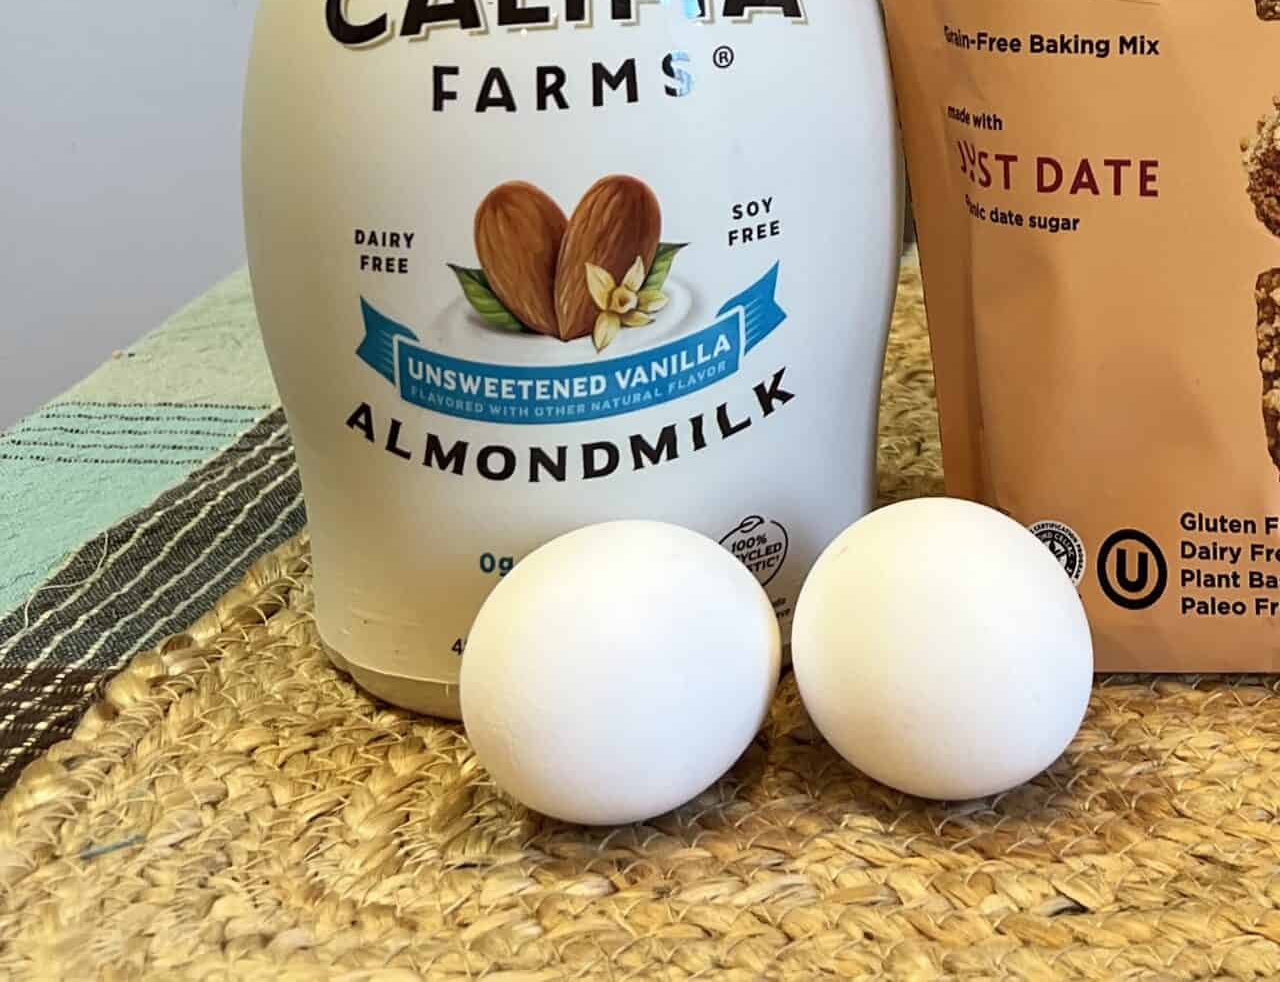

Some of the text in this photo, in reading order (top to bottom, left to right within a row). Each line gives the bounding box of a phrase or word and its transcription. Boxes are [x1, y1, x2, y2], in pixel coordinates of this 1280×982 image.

[1029, 34, 1110, 58] Baking
[1119, 35, 1160, 55] Mix
[973, 113, 1003, 130] with
[1036, 156, 1159, 197] DATE
[732, 197, 774, 220] SOY
[989, 207, 1023, 227] date
[1028, 213, 1080, 233] sugar
[354, 229, 415, 250] DAIRY
[728, 220, 781, 247] FREE
[360, 255, 409, 275] FREE
[408, 333, 731, 400] UNSWEETENED VANILLA
[411, 360, 726, 417] FLAVORED WITH OTHER NATURAL FLAVOR
[345, 366, 797, 483] ALMONDMILK
[1180, 511, 1257, 534] Gluten
[732, 533, 767, 553] 100%
[1180, 542, 1243, 565] Dairy
[1180, 569, 1242, 589] Plant
[1180, 597, 1247, 617] Paleo
